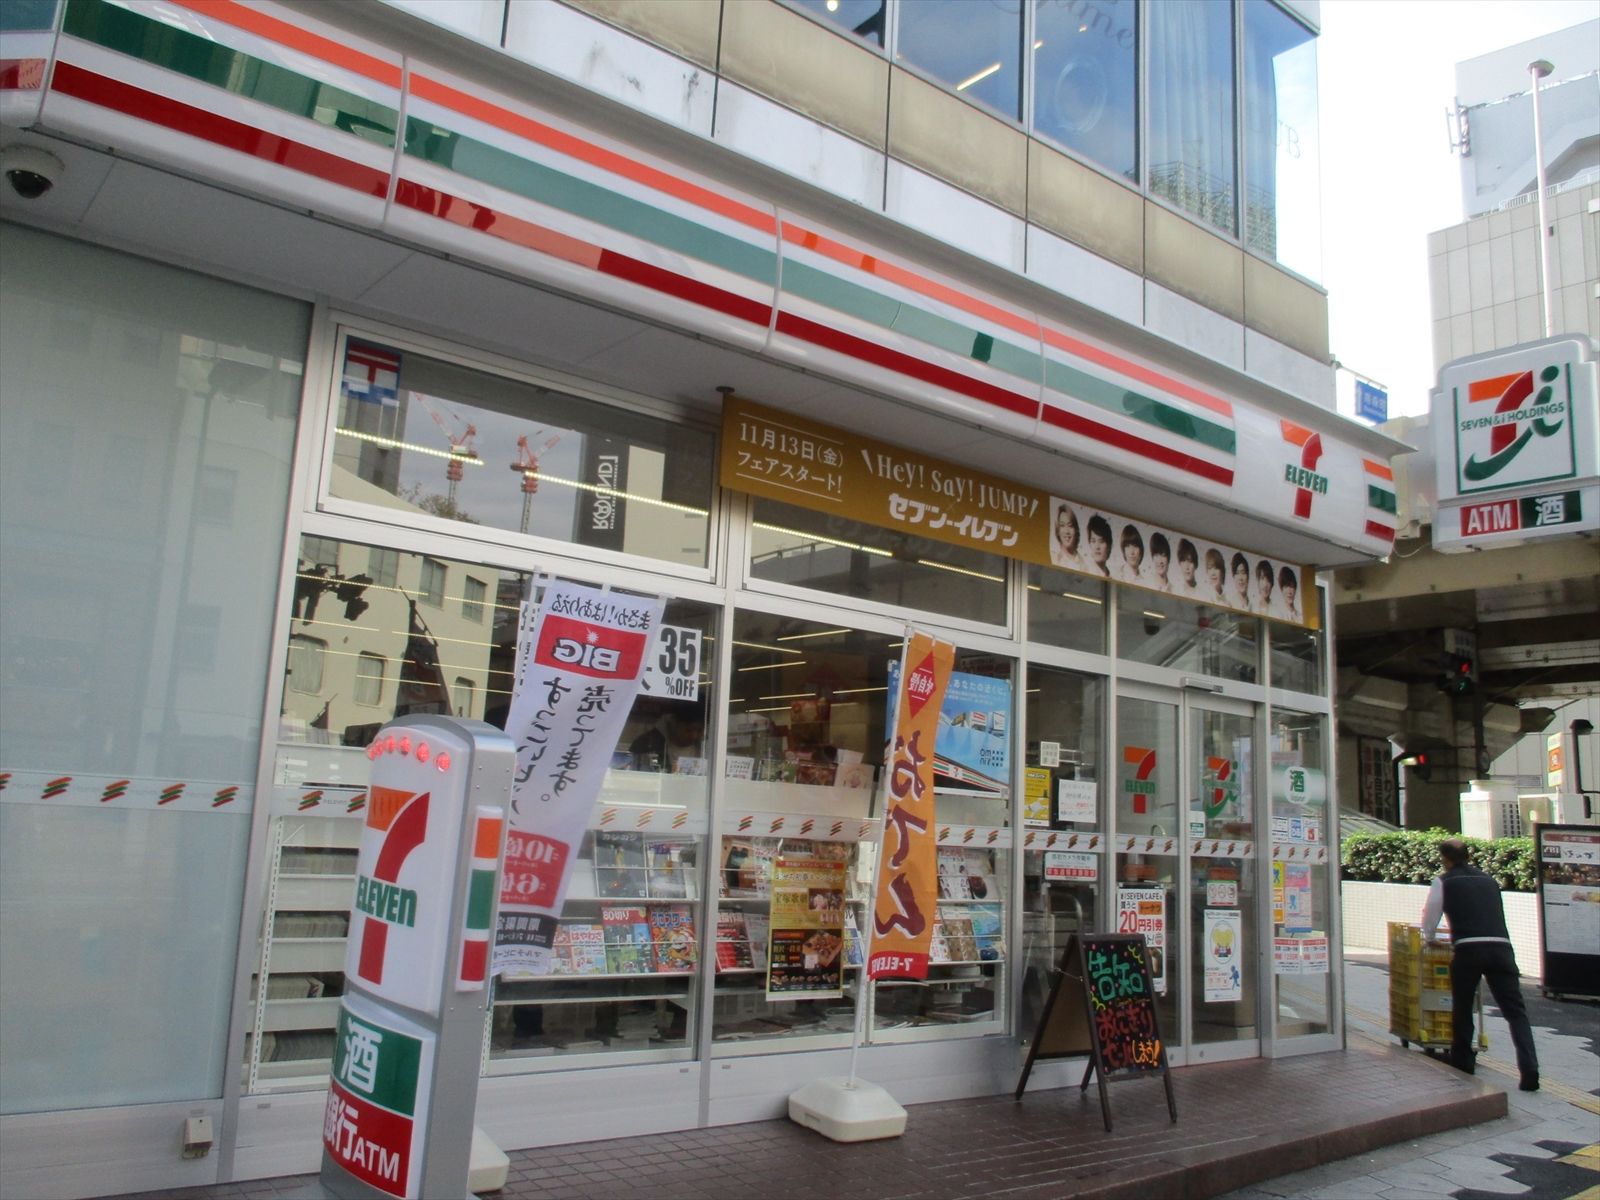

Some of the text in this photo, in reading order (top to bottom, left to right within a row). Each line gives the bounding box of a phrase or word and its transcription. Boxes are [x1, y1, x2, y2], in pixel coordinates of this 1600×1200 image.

[737, 451, 843, 495] フェアスタート!
[877, 453, 925, 488] Hey!
[931, 470, 973, 501] Say!
[1467, 504, 1511, 534] ATM
[1535, 495, 1565, 526] 酒
[658, 627, 697, 677] 35
[664, 676, 695, 698] %OFF
[1289, 769, 1305, 793] 酒
[340, 1017, 382, 1094] 酒
